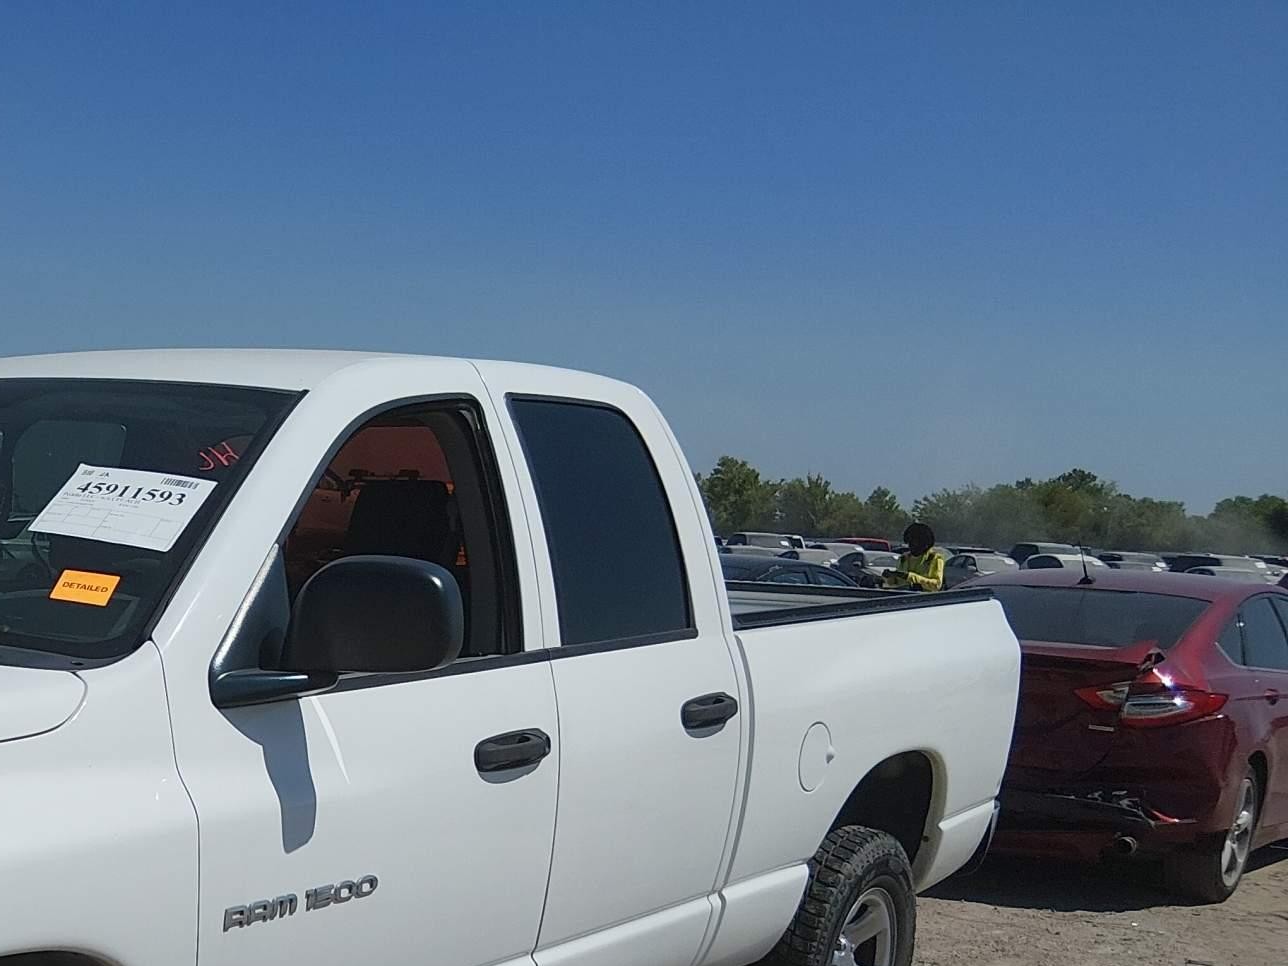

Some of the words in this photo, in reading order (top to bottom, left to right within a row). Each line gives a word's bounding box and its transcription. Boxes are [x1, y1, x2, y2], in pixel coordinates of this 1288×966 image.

[76, 481, 187, 506] 45911593
[62, 581, 109, 594] DETAILED
[222, 893, 298, 932] RAM
[305, 874, 379, 912] 1500
